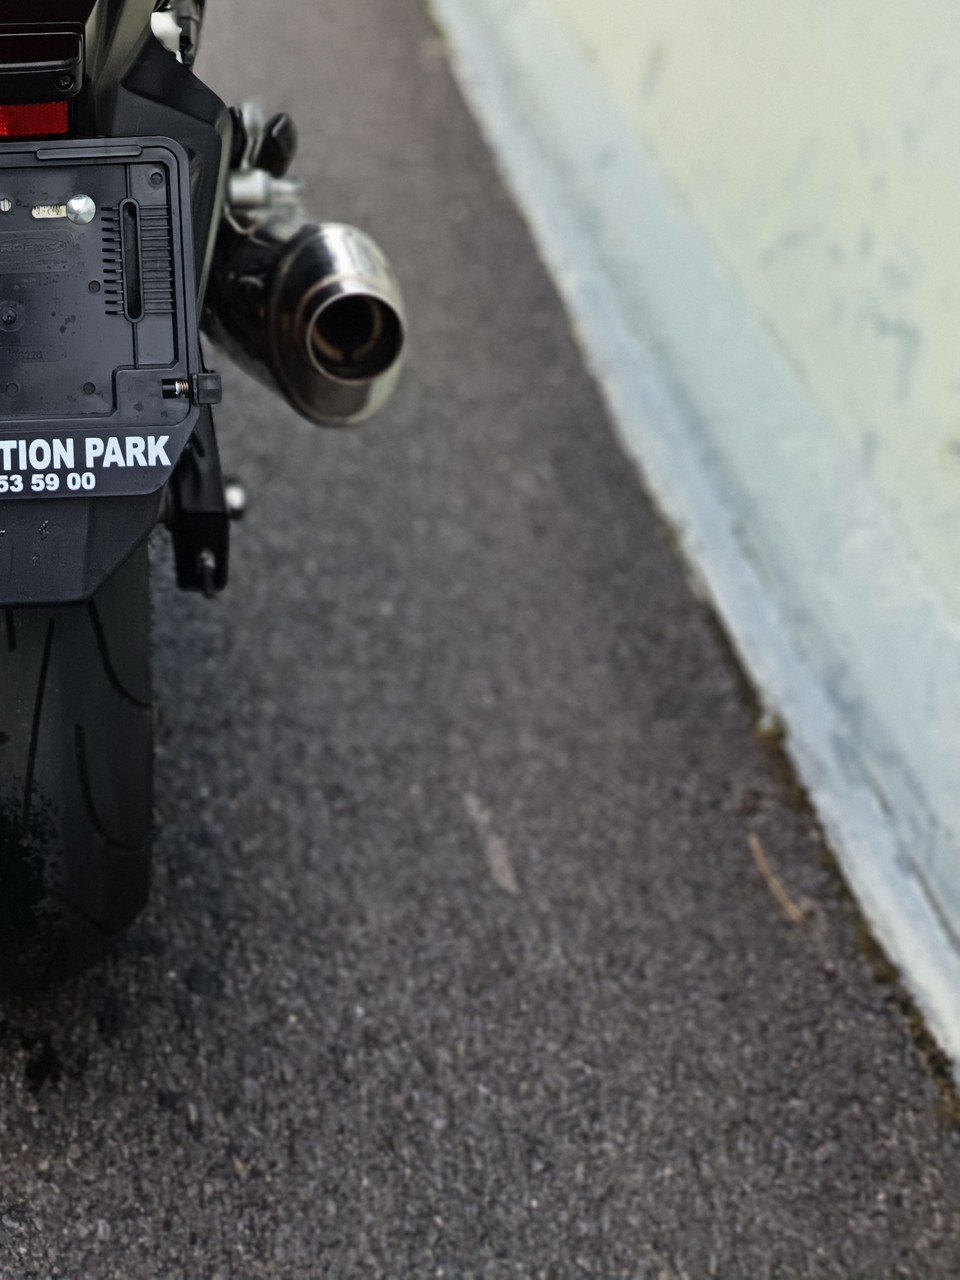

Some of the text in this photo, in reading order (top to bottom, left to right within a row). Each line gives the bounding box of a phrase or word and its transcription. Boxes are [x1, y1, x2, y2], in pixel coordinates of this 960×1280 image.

[85, 435, 171, 468] PARK
[31, 473, 59, 491] 59
[67, 472, 96, 490] 00
